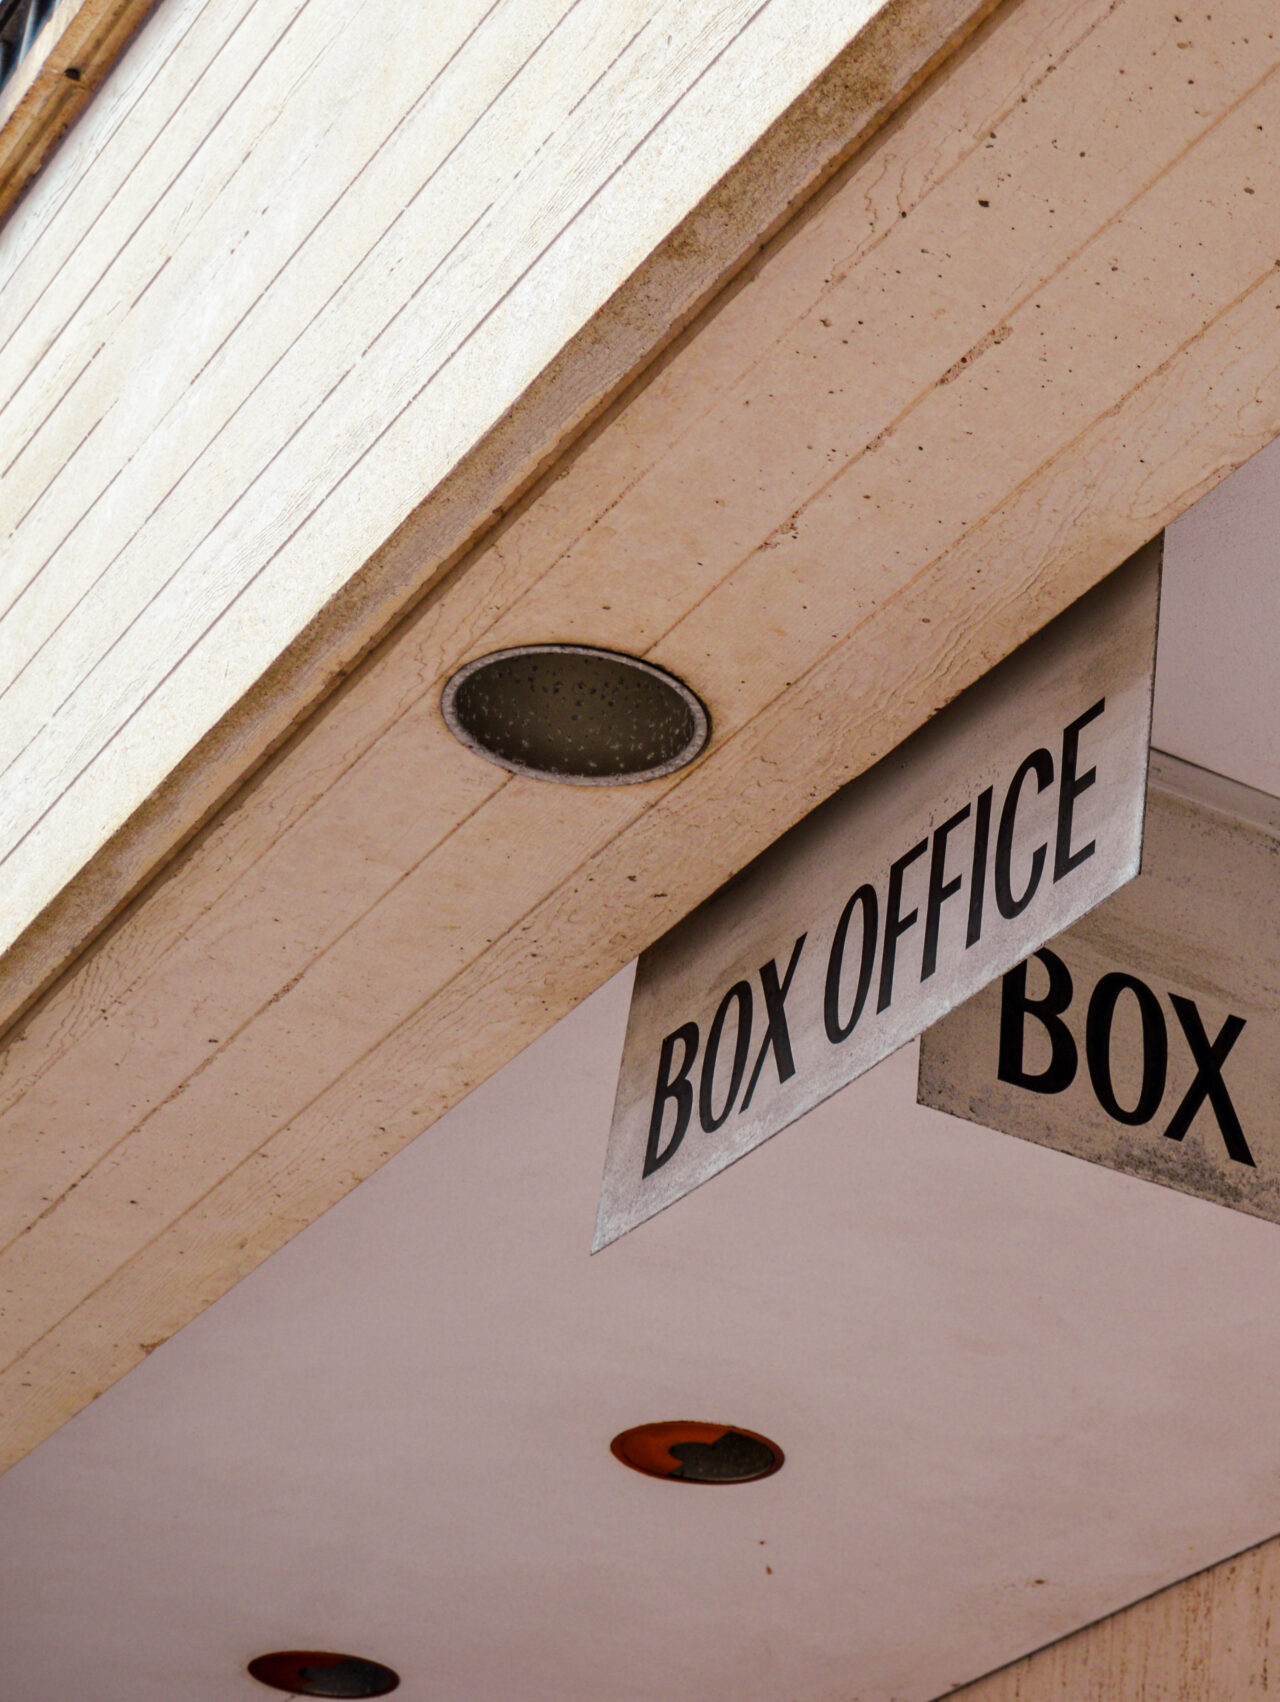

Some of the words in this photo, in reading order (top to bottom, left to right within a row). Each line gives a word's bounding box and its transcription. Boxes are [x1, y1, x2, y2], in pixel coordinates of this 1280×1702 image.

[642, 931, 808, 1180] BOX
[823, 697, 1106, 1045] OFFICE
[997, 947, 1257, 1168] BOX
